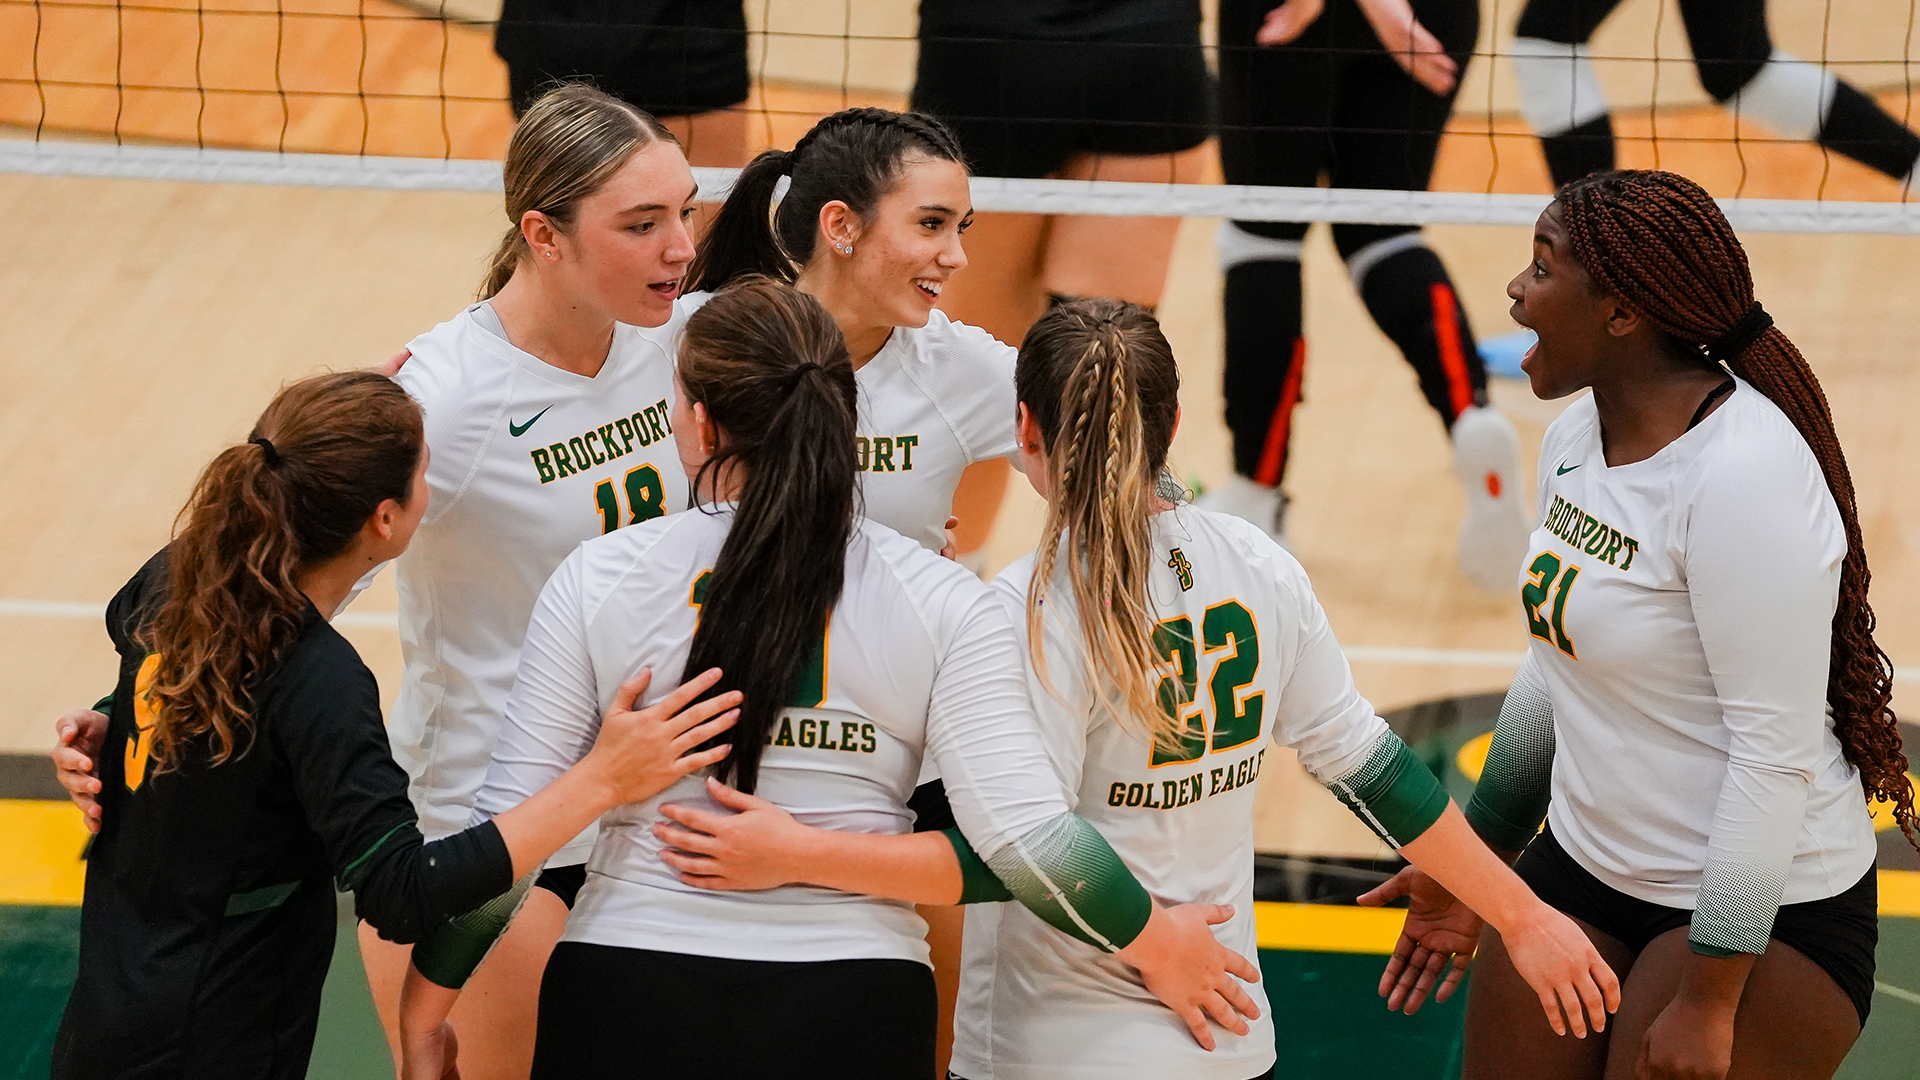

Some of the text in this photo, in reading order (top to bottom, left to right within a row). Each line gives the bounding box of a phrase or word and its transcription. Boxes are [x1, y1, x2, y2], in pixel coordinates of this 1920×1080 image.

[530, 398, 673, 485] BROCKPORT
[593, 462, 667, 536] 18
[1543, 494, 1640, 572] BROCKPORT
[1521, 550, 1582, 661] 21
[1148, 597, 1266, 769] 22
[766, 716, 877, 754] AGLES
[1107, 747, 1266, 810] GOLDEN EAGLE
